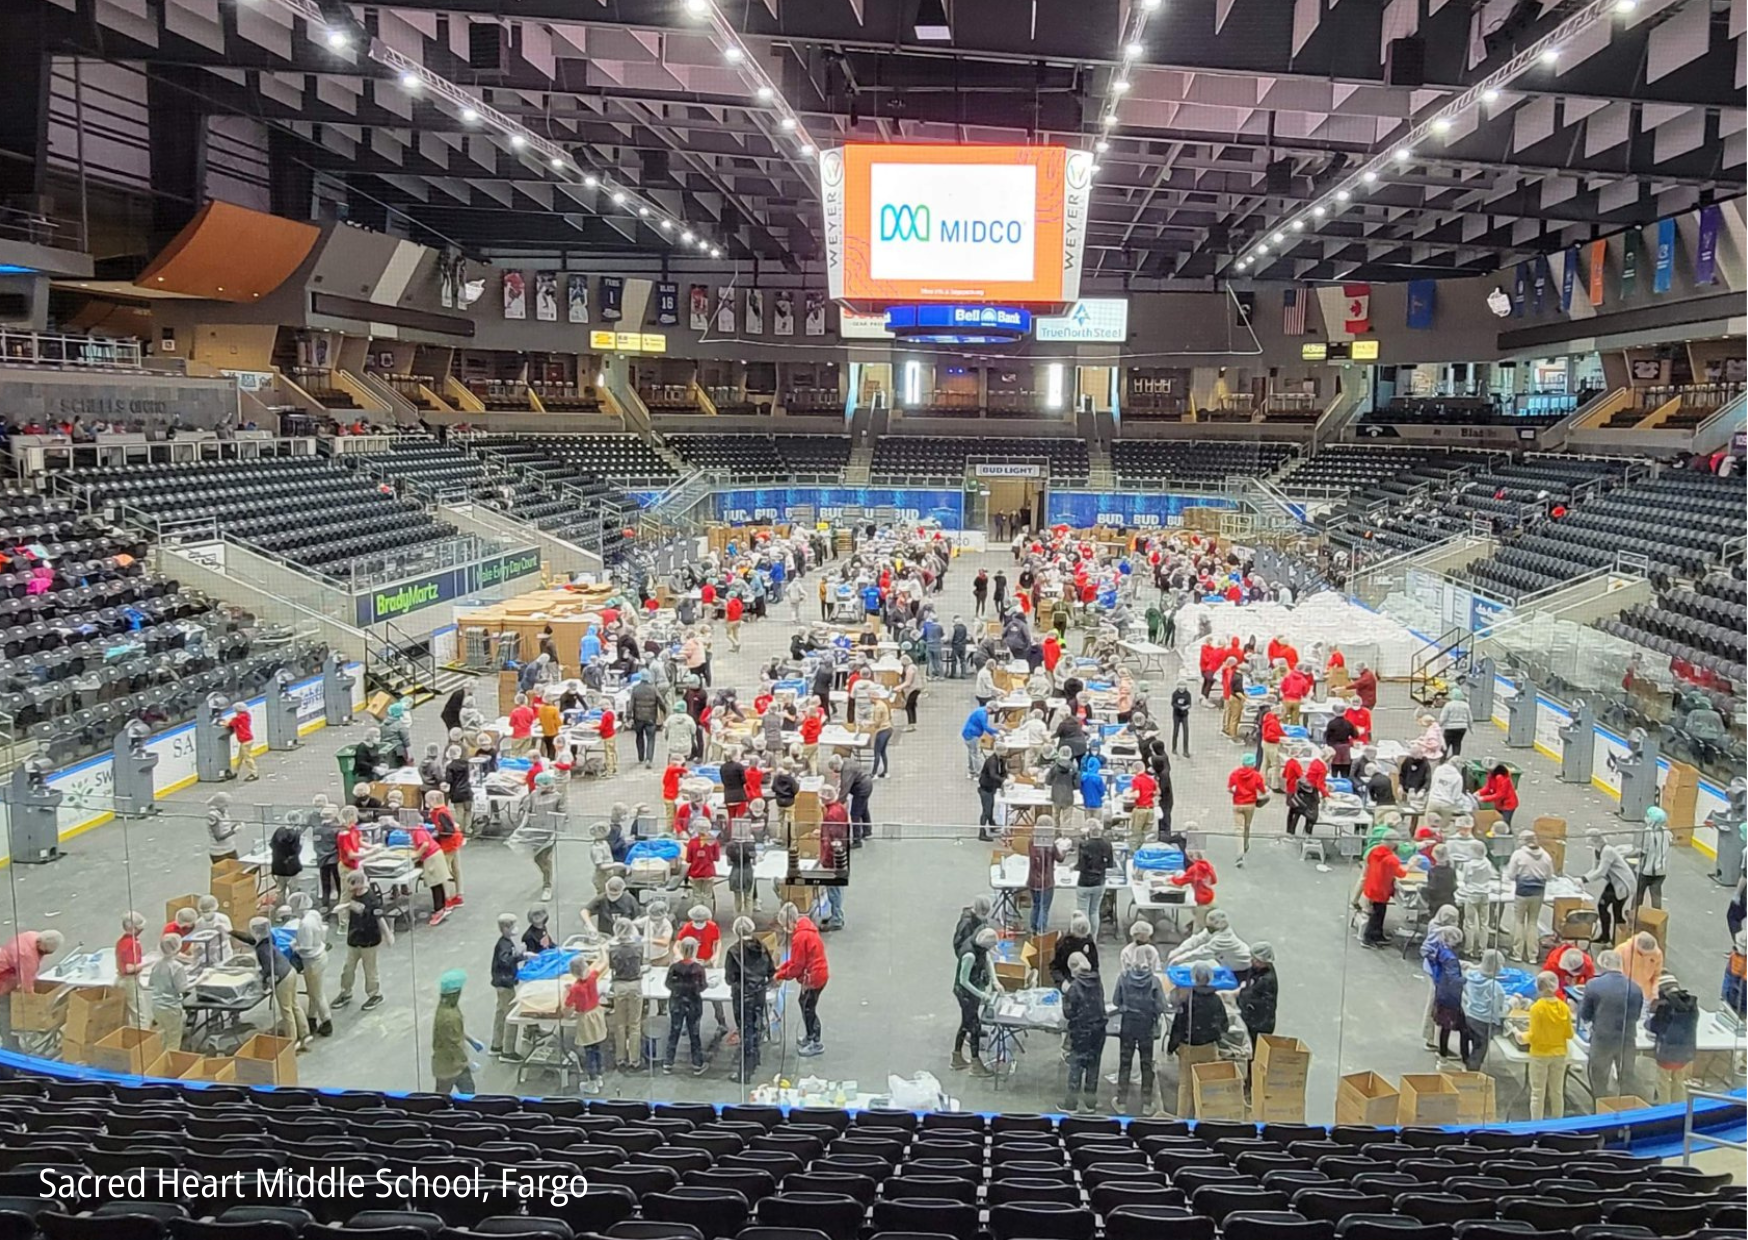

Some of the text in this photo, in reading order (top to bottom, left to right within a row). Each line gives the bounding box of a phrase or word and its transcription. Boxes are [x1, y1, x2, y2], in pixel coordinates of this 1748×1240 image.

[827, 191, 839, 268] WEYER
[941, 219, 1021, 243] MIDCO
[1064, 194, 1079, 270] WEYER
[955, 308, 1021, 325] Bell Bank
[1097, 513, 1124, 525] BUD
[1133, 515, 1159, 526] BUD
